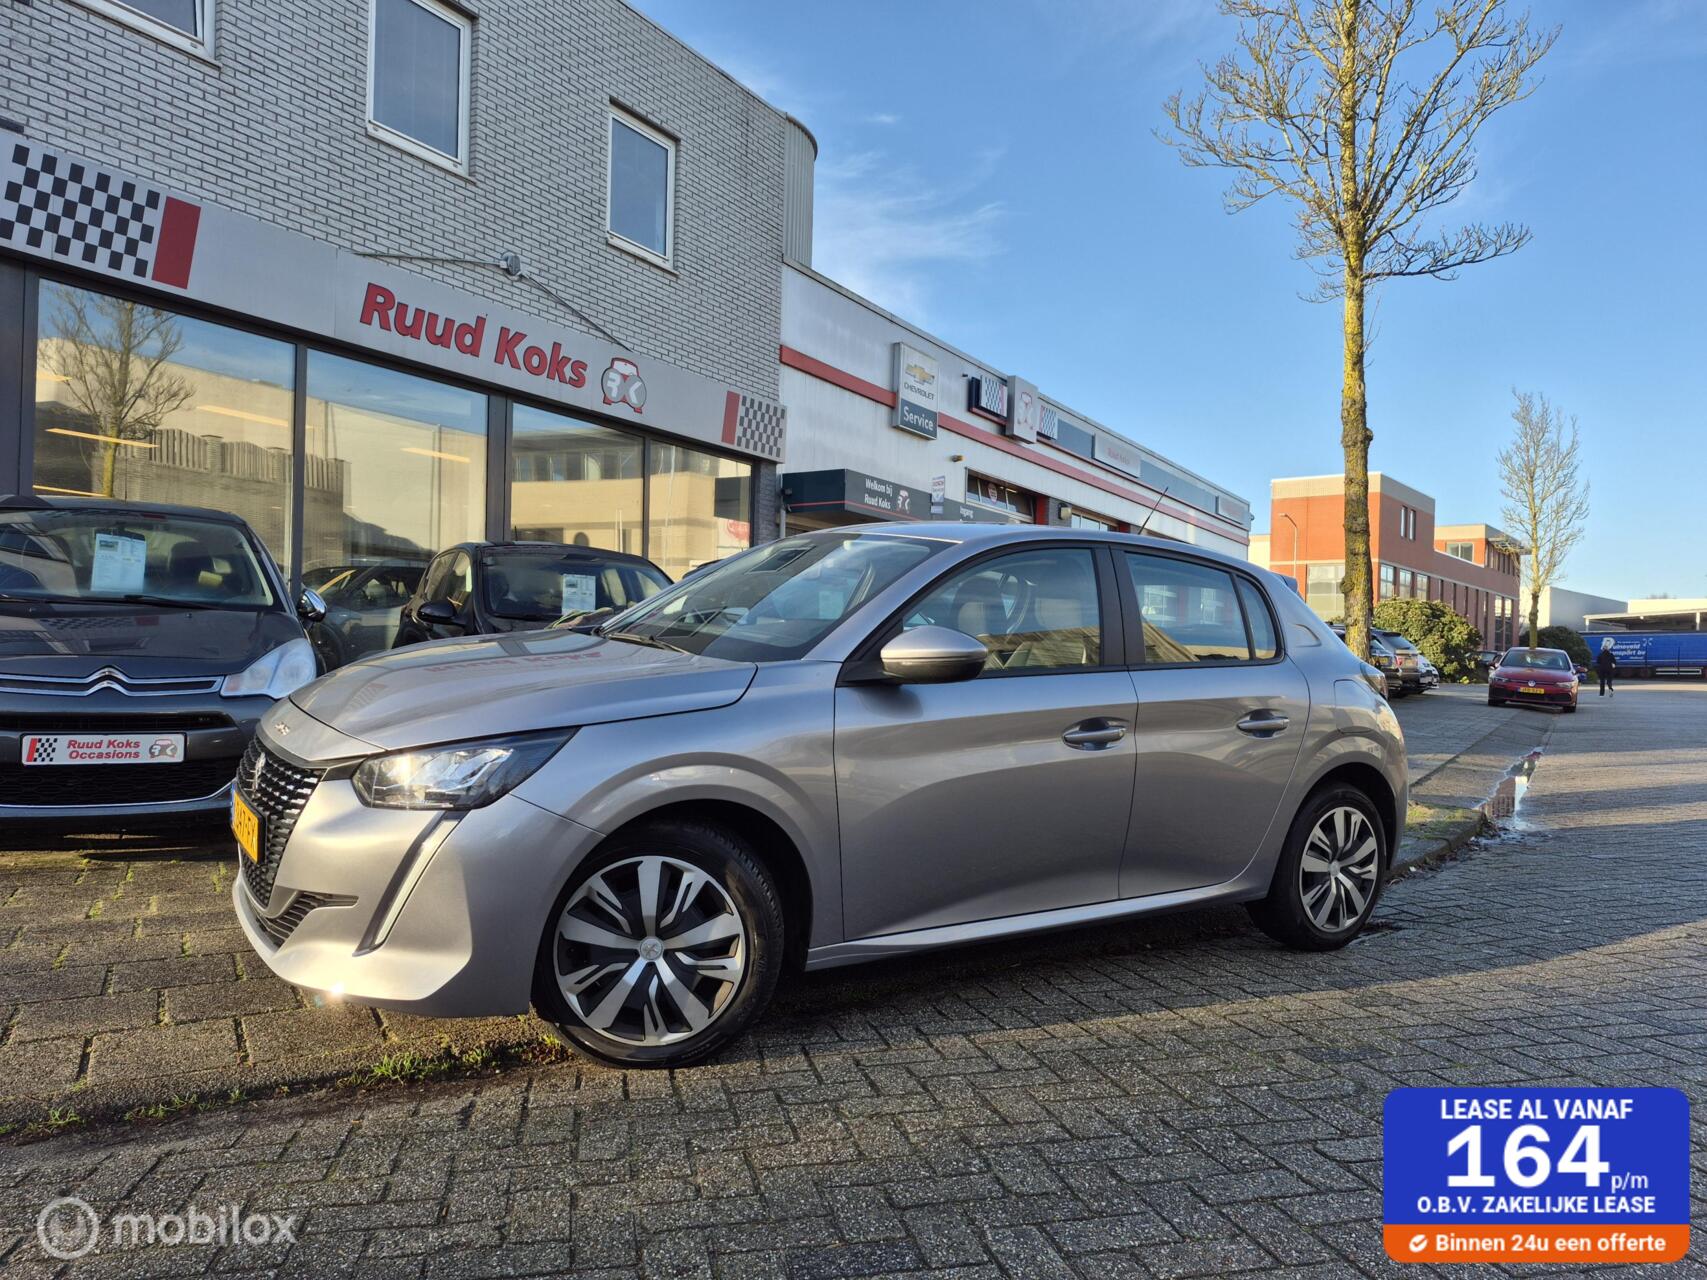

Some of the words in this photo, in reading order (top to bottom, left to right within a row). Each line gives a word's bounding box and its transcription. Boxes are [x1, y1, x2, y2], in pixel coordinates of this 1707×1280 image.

[360, 282, 487, 357] Ruud
[494, 326, 588, 388] Koks
[904, 382, 935, 401] CHEVROLET
[903, 405, 934, 431] Service
[865, 478, 885, 494] Welkom
[885, 483, 893, 497] bij
[864, 495, 878, 506] Ruud
[878, 497, 891, 510] Koks
[67, 739, 101, 749] Ruud
[106, 738, 141, 749] Koks
[68, 750, 140, 760] Occasions
